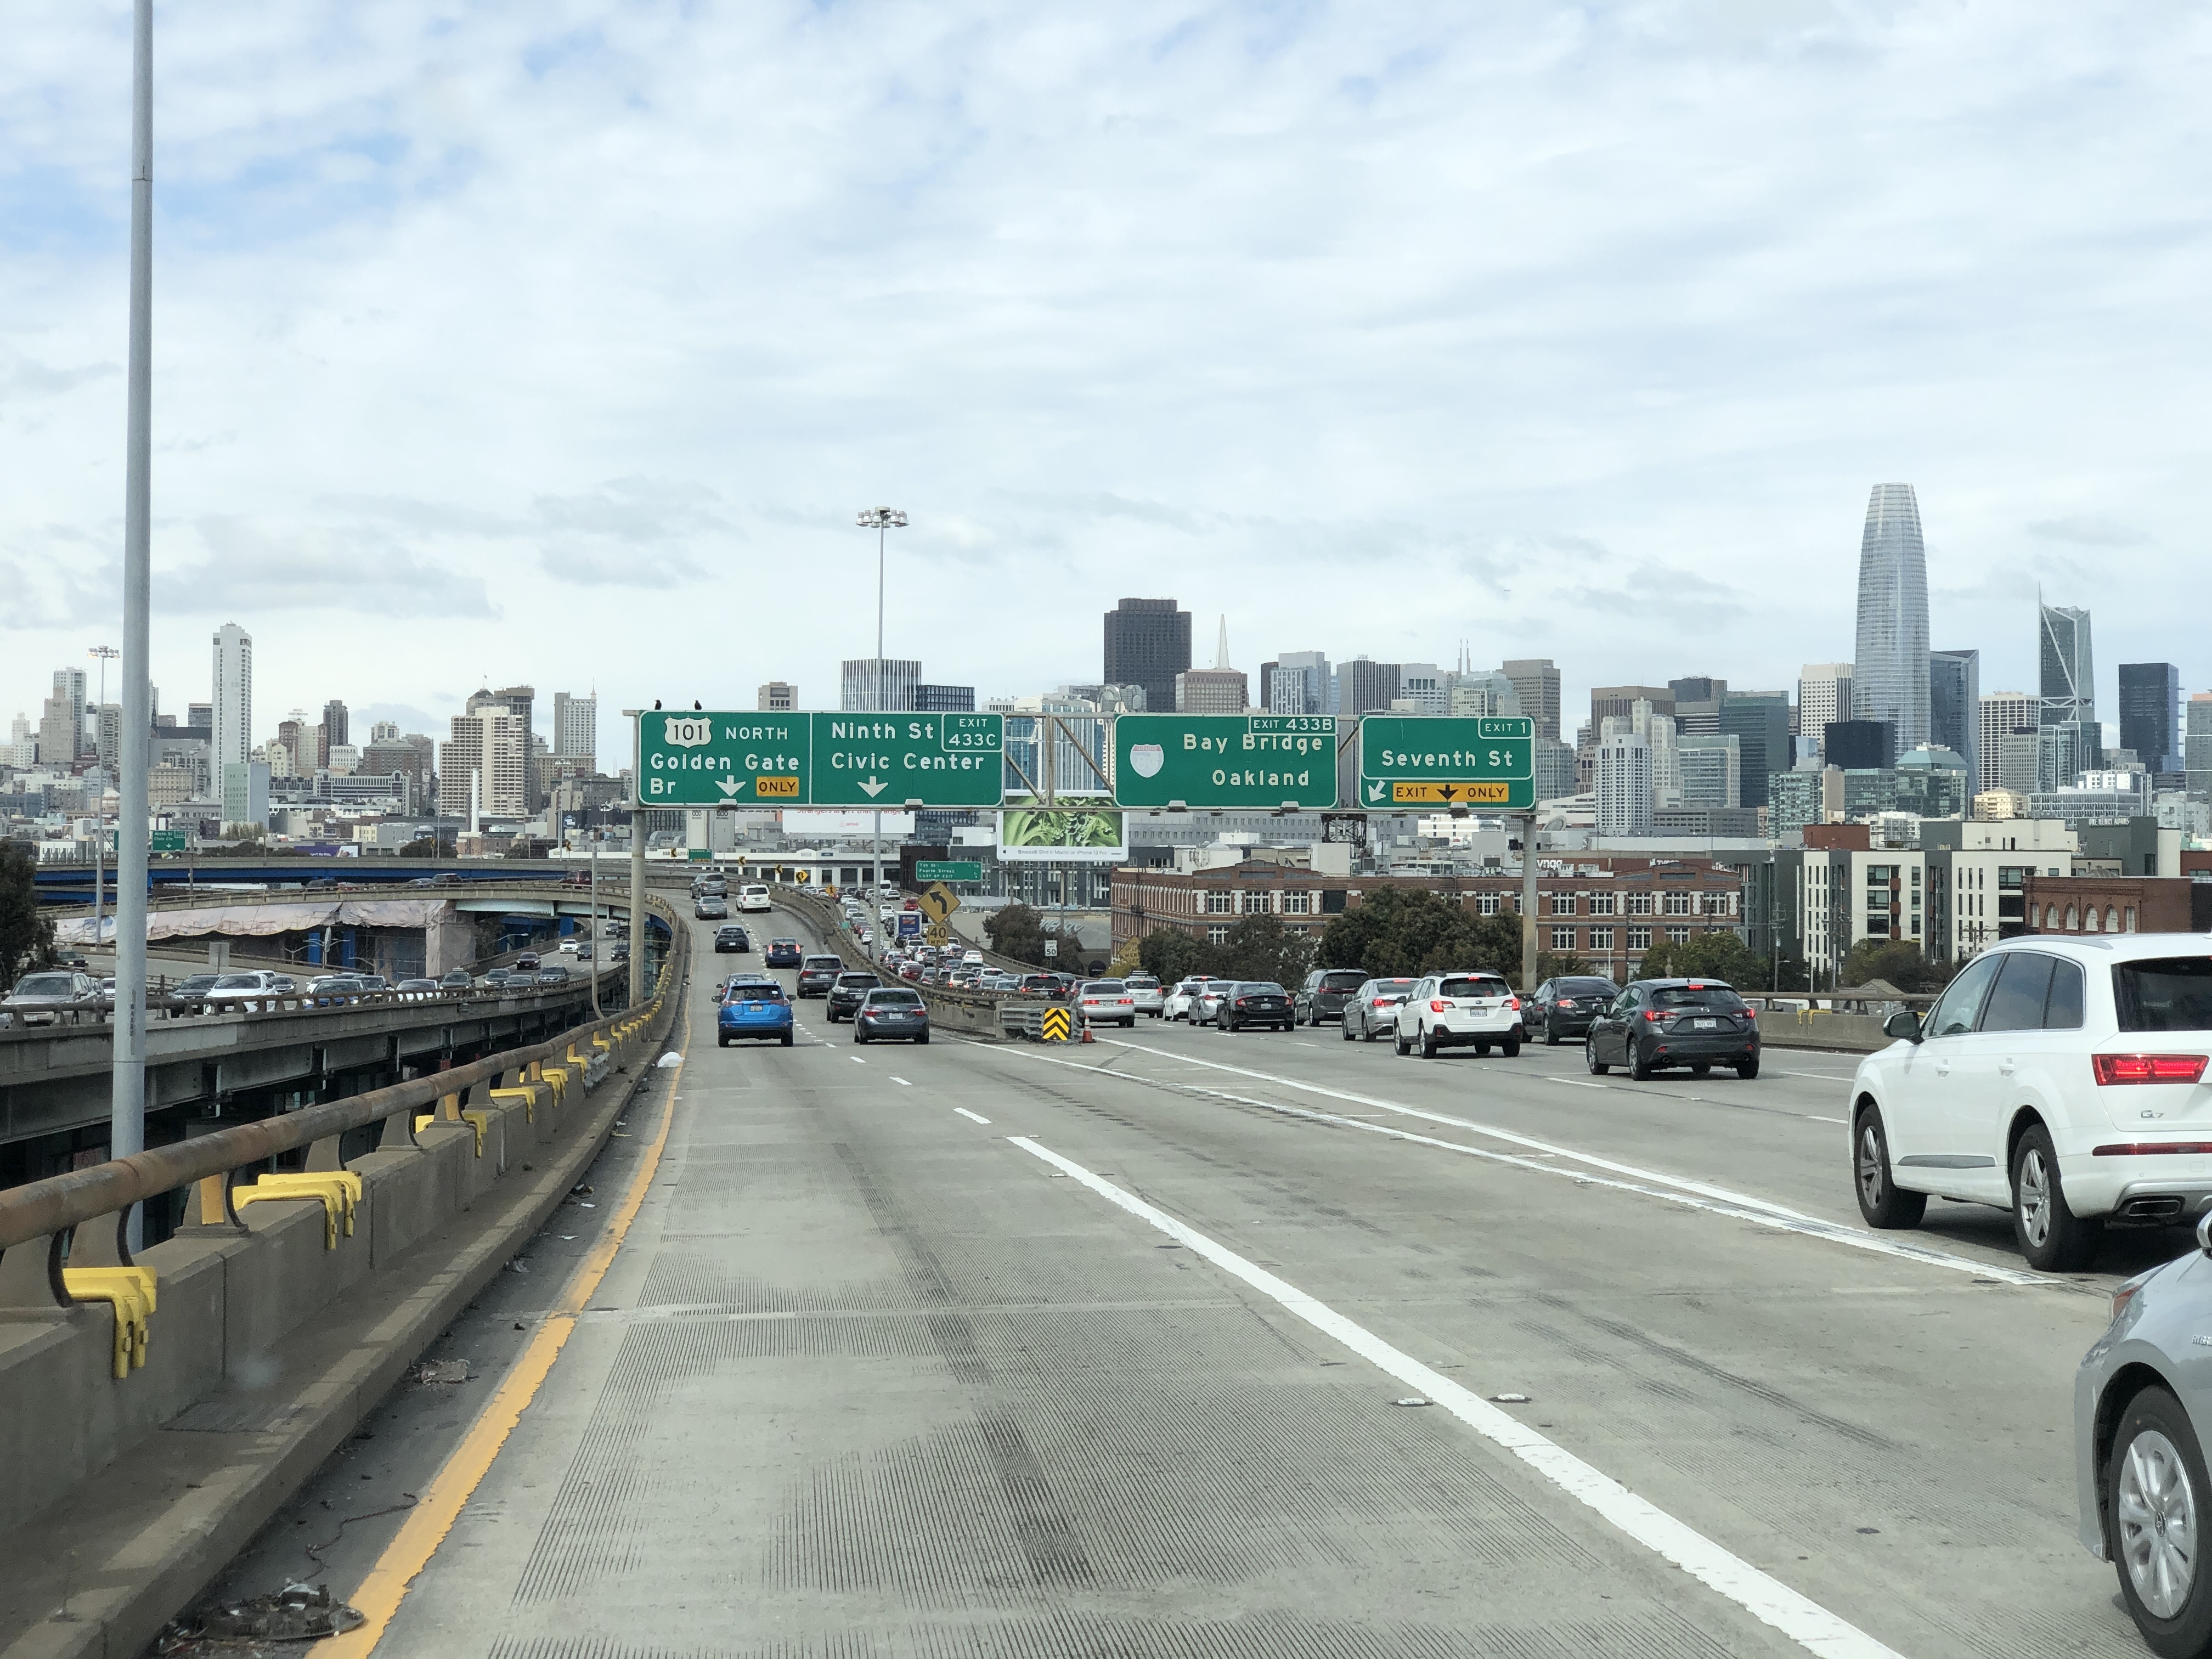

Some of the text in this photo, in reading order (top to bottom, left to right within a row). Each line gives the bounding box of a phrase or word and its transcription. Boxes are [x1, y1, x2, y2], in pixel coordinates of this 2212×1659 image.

[959, 718, 988, 727] EXIT
[1254, 718, 1333, 731] EXIT 433B
[1485, 721, 1526, 734] EXIT 1
[674, 724, 703, 740] 101
[726, 727, 788, 740] NORTH
[832, 722, 934, 739] Ninth St
[949, 733, 996, 746] 433C
[1183, 733, 1323, 756] Bay Bridge
[651, 753, 799, 770] Golden Gate
[832, 752, 984, 770] Civic Center
[1381, 750, 1513, 766] Seventh St
[1212, 769, 1309, 786] Oakland
[650, 777, 676, 794] Br
[759, 781, 797, 792] ONLY
[1396, 787, 1505, 798] EXIT ONLY
[930, 927, 947, 938] 40
[2140, 1110, 2165, 1119] Q7
